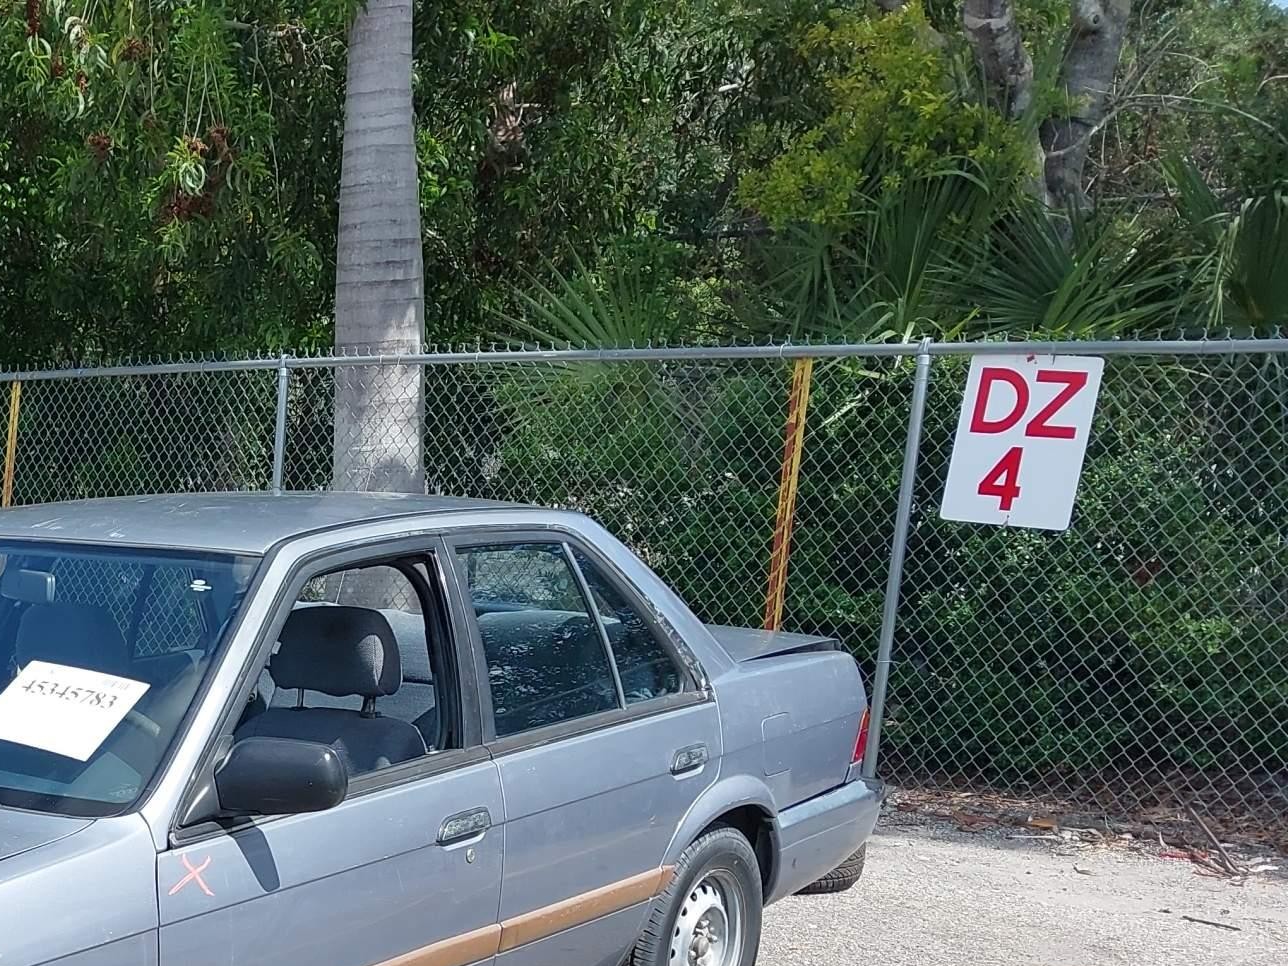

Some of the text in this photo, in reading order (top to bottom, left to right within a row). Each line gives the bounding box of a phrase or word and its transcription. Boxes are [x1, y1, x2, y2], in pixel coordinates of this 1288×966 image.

[970, 367, 1088, 439] DZ
[977, 447, 1024, 511] 4
[22, 679, 118, 709] 45345783
